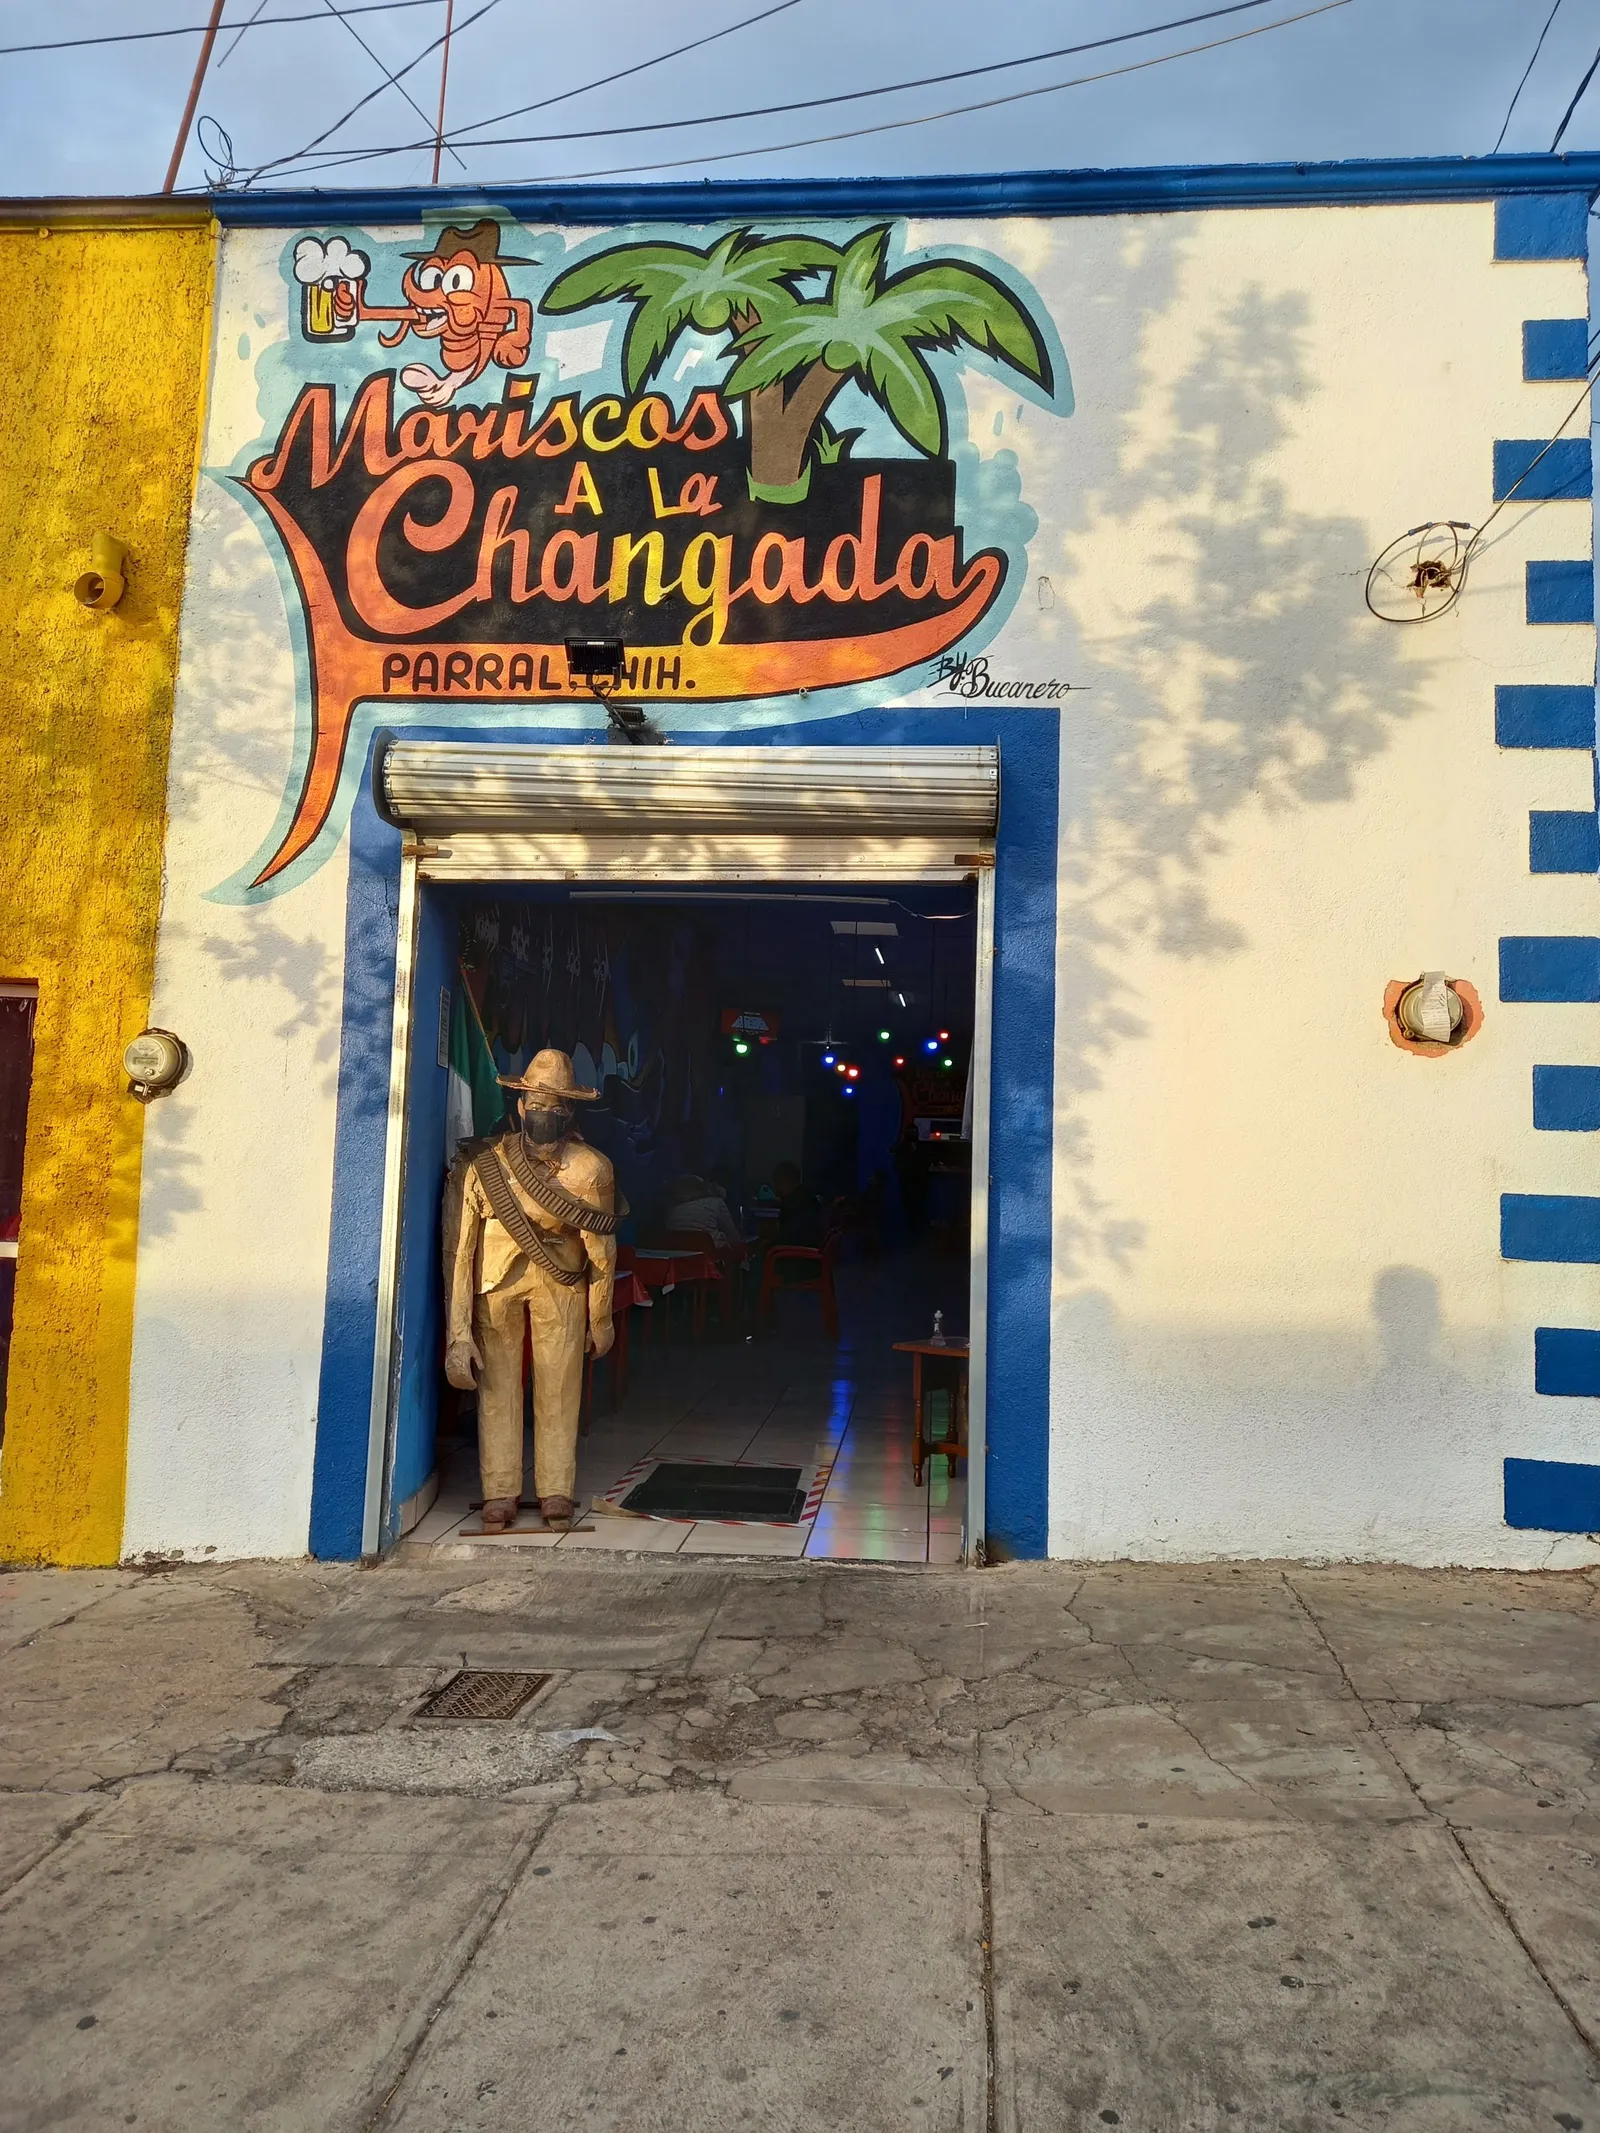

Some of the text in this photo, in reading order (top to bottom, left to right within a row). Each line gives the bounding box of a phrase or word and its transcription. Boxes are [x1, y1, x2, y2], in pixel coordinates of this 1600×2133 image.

[250, 376, 729, 491] Mariscos
[555, 461, 723, 519] A La
[346, 458, 980, 646] Changada
[958, 656, 1078, 699] Bucanero
